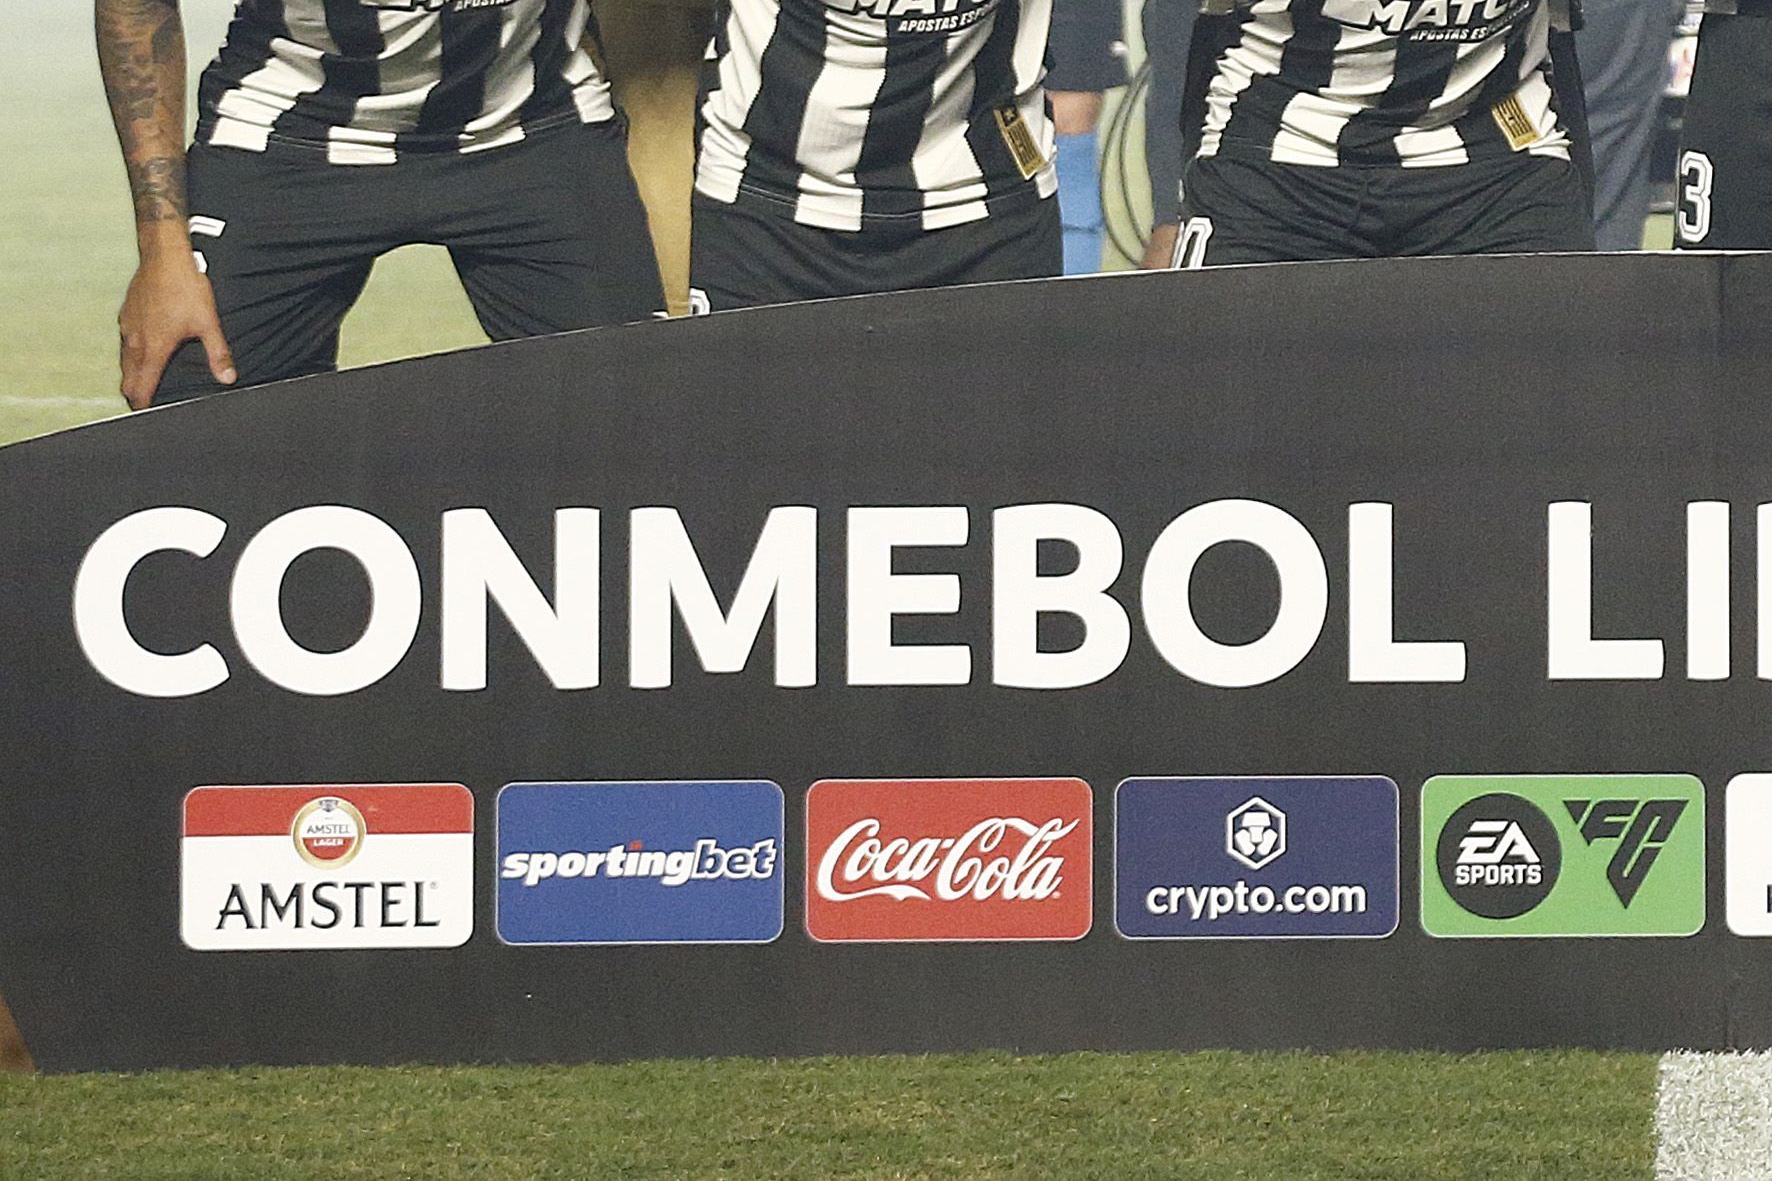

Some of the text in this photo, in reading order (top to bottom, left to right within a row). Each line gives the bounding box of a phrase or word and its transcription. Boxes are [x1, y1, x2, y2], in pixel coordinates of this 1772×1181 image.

[898, 15, 957, 32] APOSTAS
[1679, 150, 1714, 243] 3
[74, 499, 1466, 697] CONMEBOL
[306, 823, 351, 834] AMSTEL
[313, 837, 344, 847] LAGER
[1456, 820, 1540, 863] EA
[501, 838, 777, 887] sportingbet
[817, 817, 1081, 902] Coca-Cola
[1455, 864, 1543, 886] SPORTS
[216, 881, 440, 930] AMSTEL
[1146, 880, 1366, 920] crypto.com
